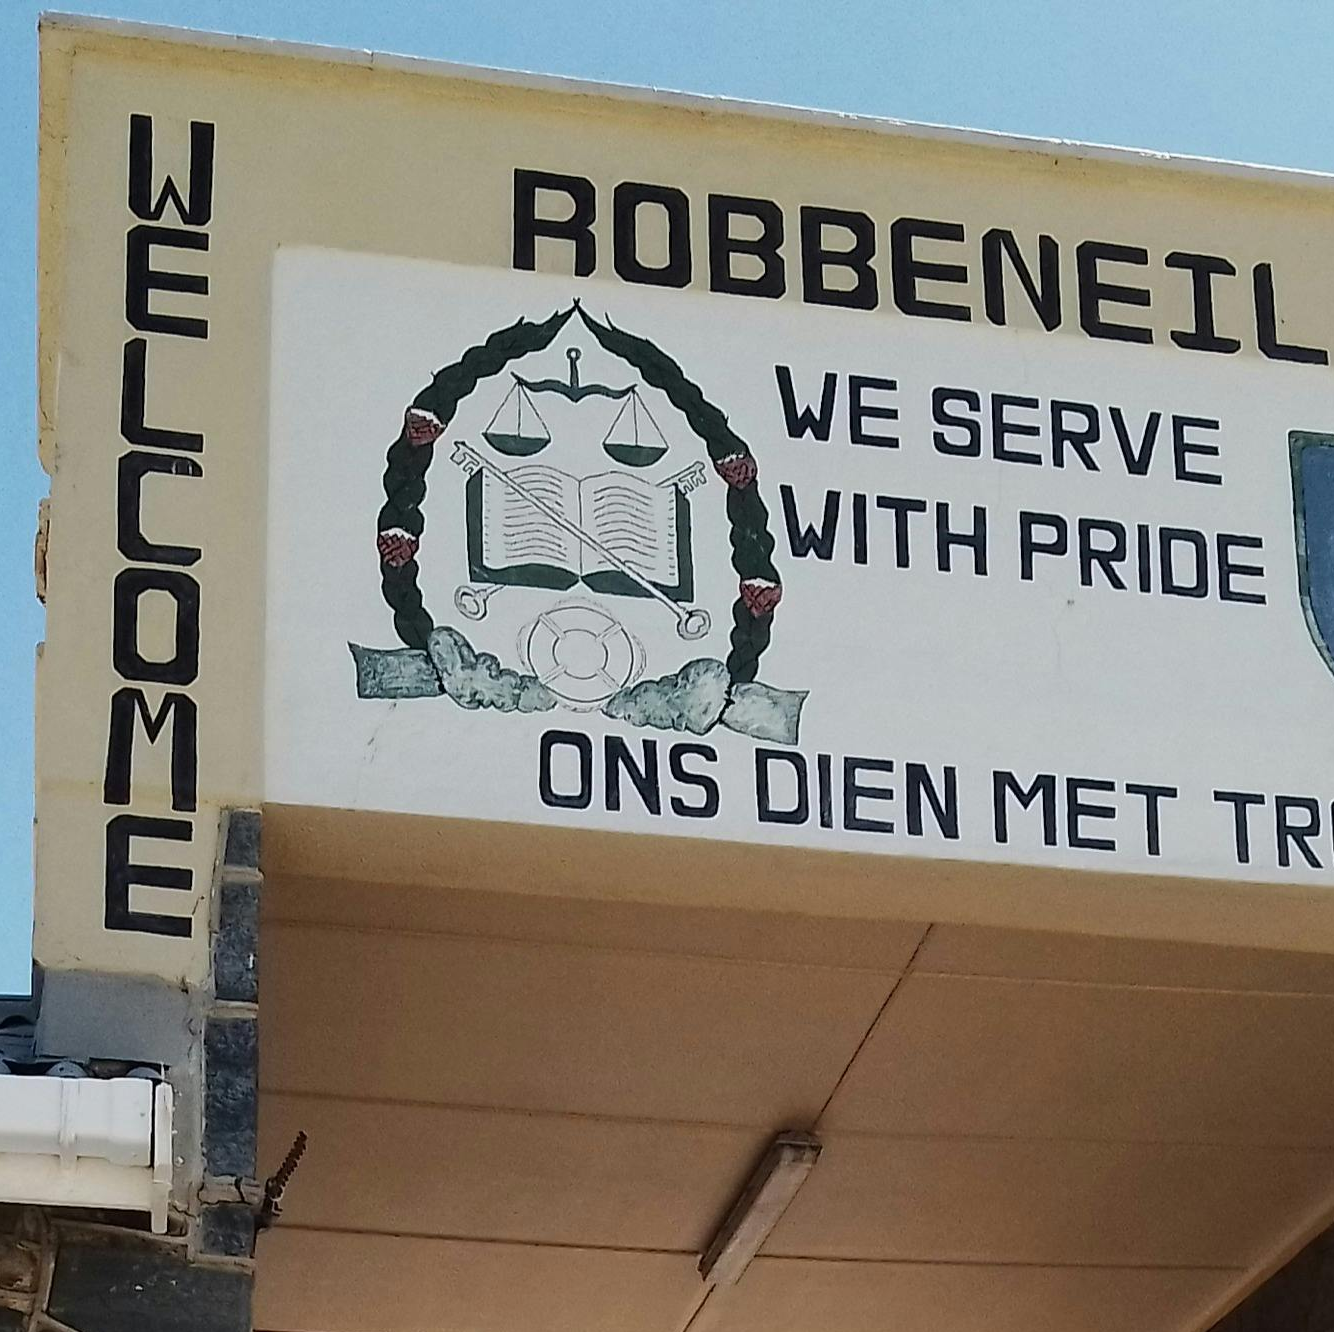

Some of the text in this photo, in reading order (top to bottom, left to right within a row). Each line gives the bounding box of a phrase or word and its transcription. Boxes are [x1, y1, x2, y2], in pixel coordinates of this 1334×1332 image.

[775, 365, 1223, 485] WE SERVE
[103, 113, 216, 939] WELCOME
[779, 484, 1267, 605] WITH PRIDE
[538, 729, 720, 819] ONS
[755, 747, 960, 841] DIEN
[992, 770, 1178, 856] MET
